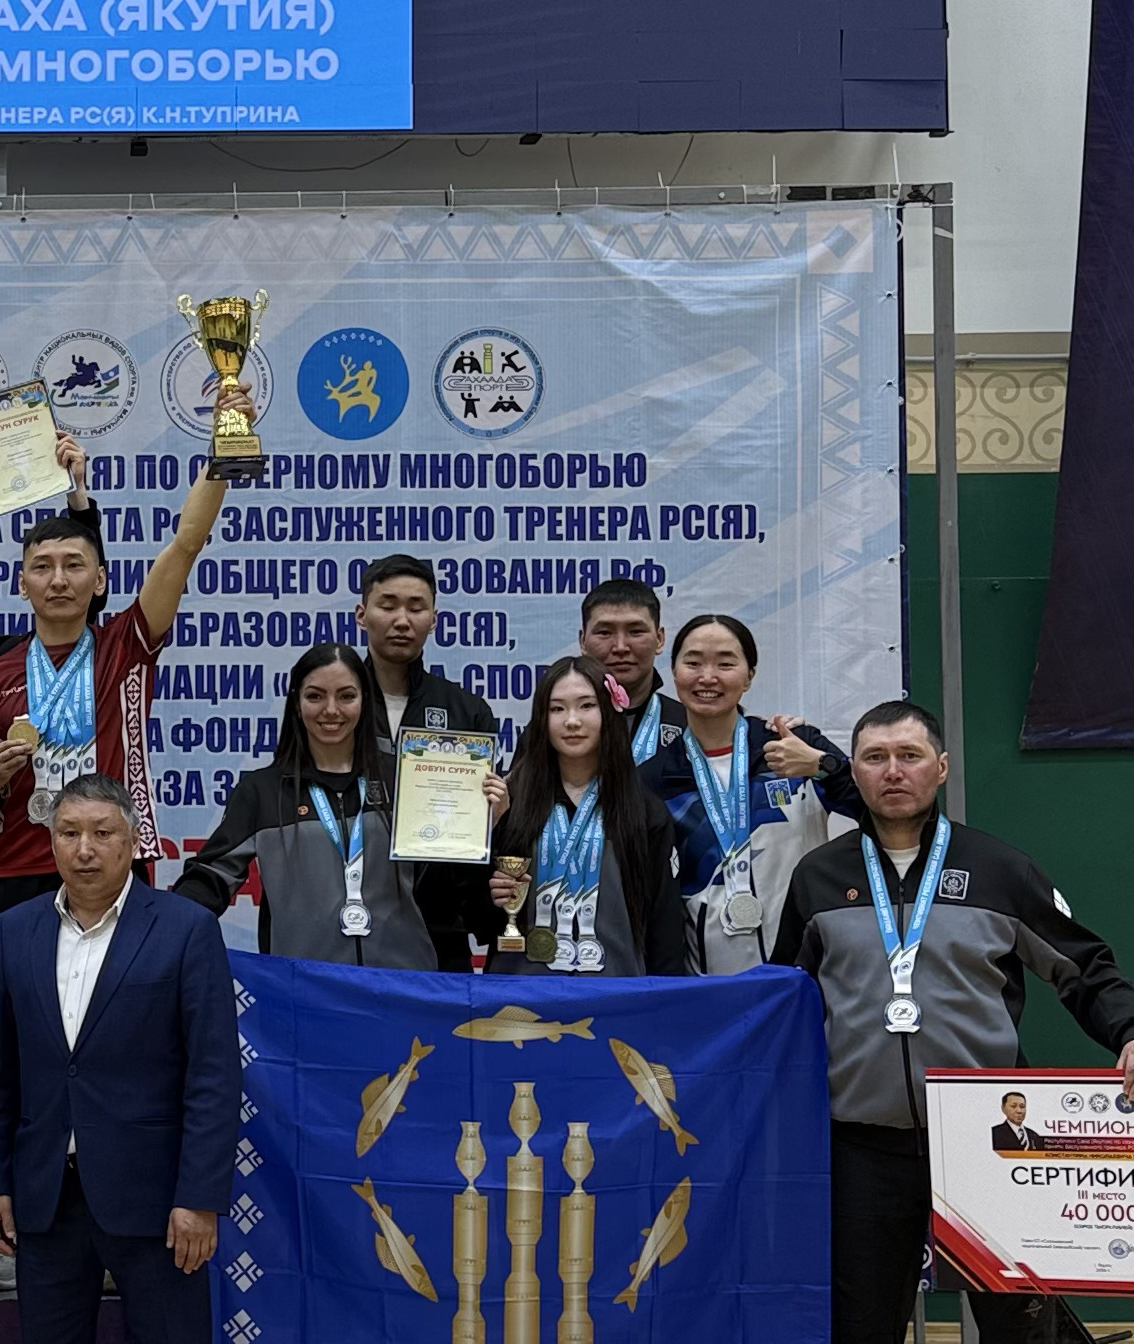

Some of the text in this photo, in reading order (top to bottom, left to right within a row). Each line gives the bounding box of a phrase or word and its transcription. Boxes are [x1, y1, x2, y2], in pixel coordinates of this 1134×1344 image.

[70, 106, 136, 129] РС(Я)
[142, 106, 301, 125] К.Н.ТУПРИНА
[136, 455, 180, 492] ПО
[400, 452, 648, 490] МНОГОБОРЬЮ
[221, 506, 496, 544] ЗАСЛУЖЕННОГО
[503, 506, 652, 543] ТРЕНЕРА
[659, 504, 766, 544] РС(Я),
[197, 559, 339, 601] ОБЩЕГО
[448, 766, 477, 776] СУРУК
[1044, 1119, 1134, 1135] ЧЕМПИОН
[1010, 1165, 1134, 1188] СЕРТИФИ
[1092, 1192, 1127, 1201] МЕСТО
[1060, 1202, 1089, 1221] 40
